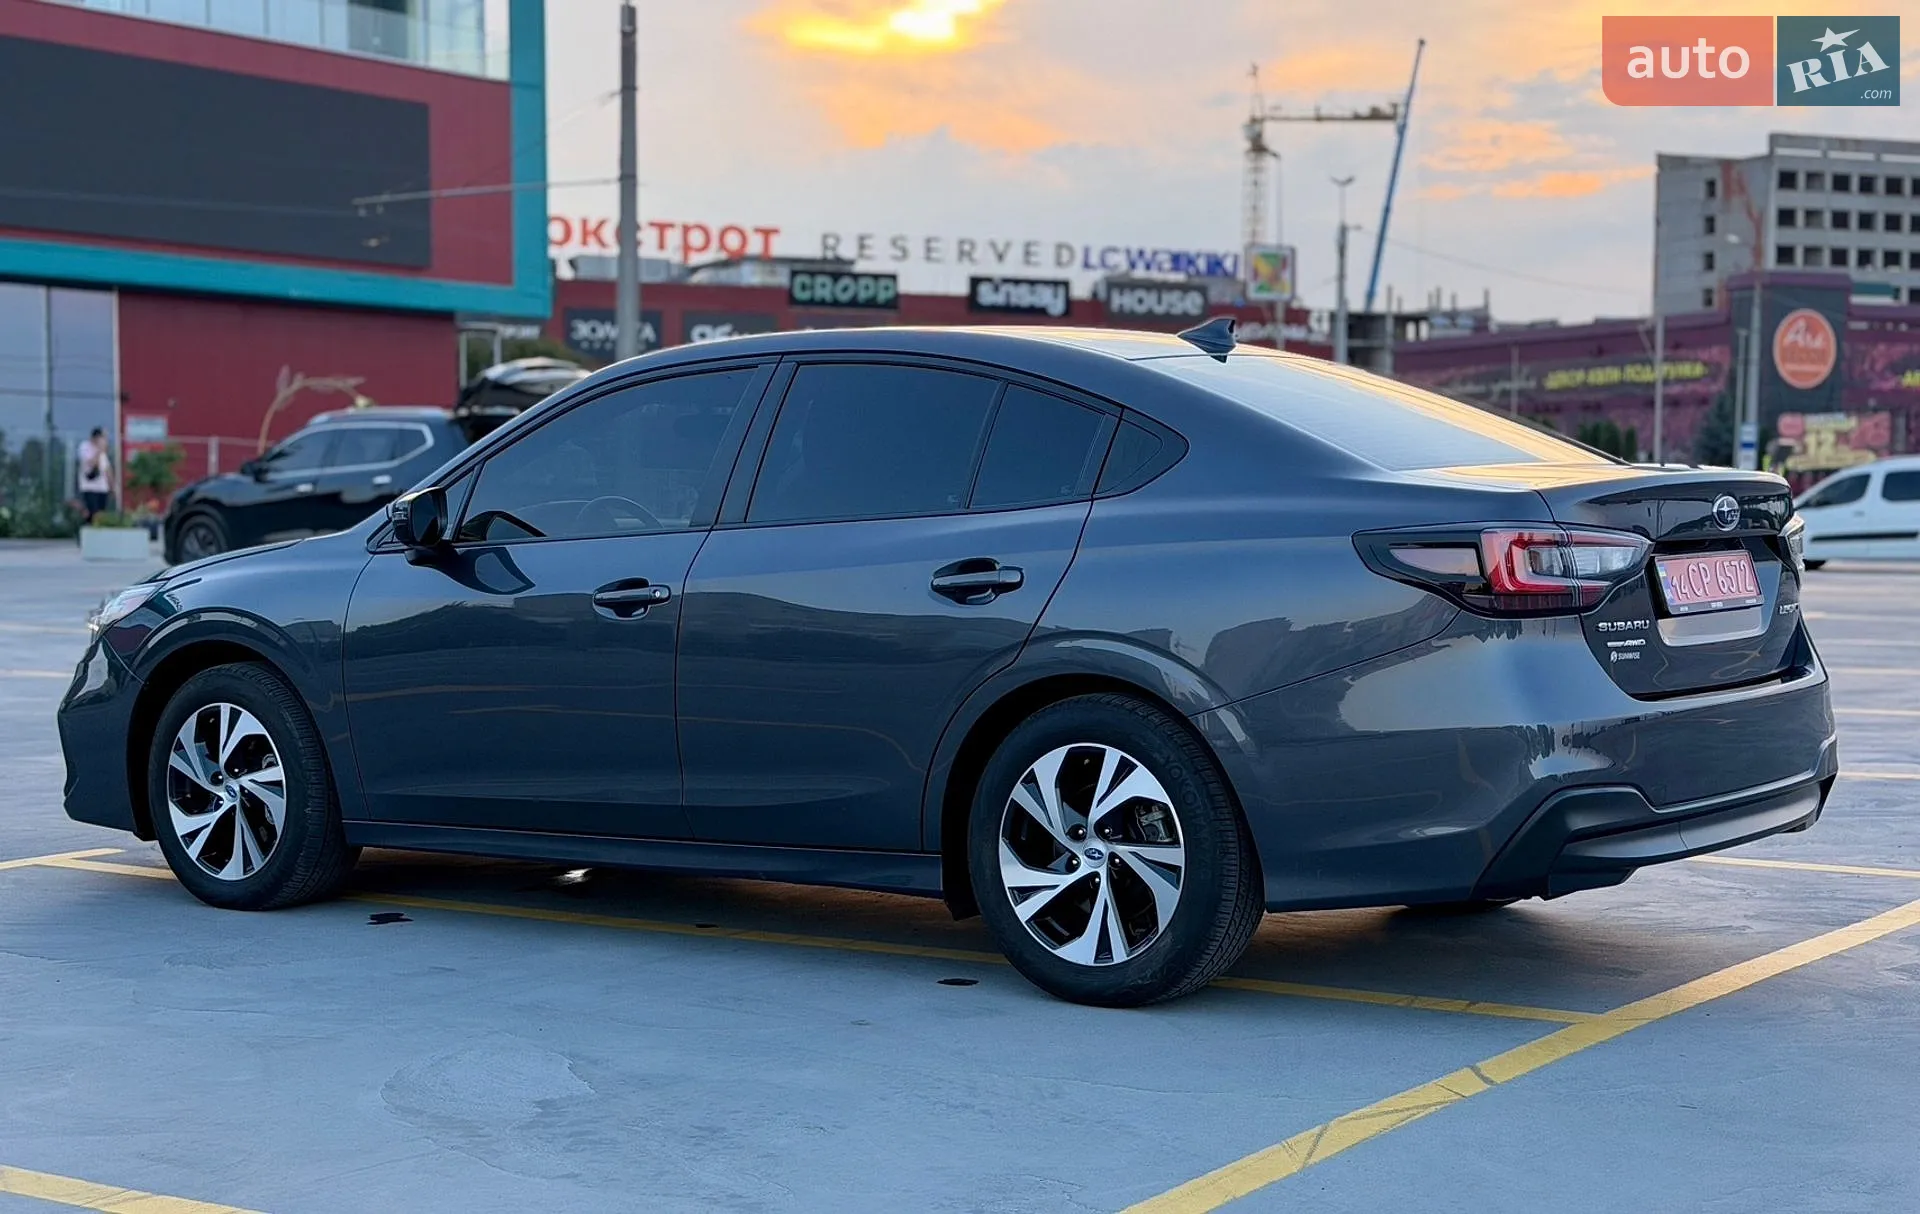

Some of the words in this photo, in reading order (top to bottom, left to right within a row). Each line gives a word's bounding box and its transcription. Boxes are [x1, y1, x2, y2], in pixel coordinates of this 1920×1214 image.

[820, 232, 1077, 268] RESERVED
[792, 273, 897, 303] CROPP
[1109, 286, 1205, 316] HOUSE
[1715, 559, 1756, 595] 6572
[1598, 620, 1650, 632] SUBARU
